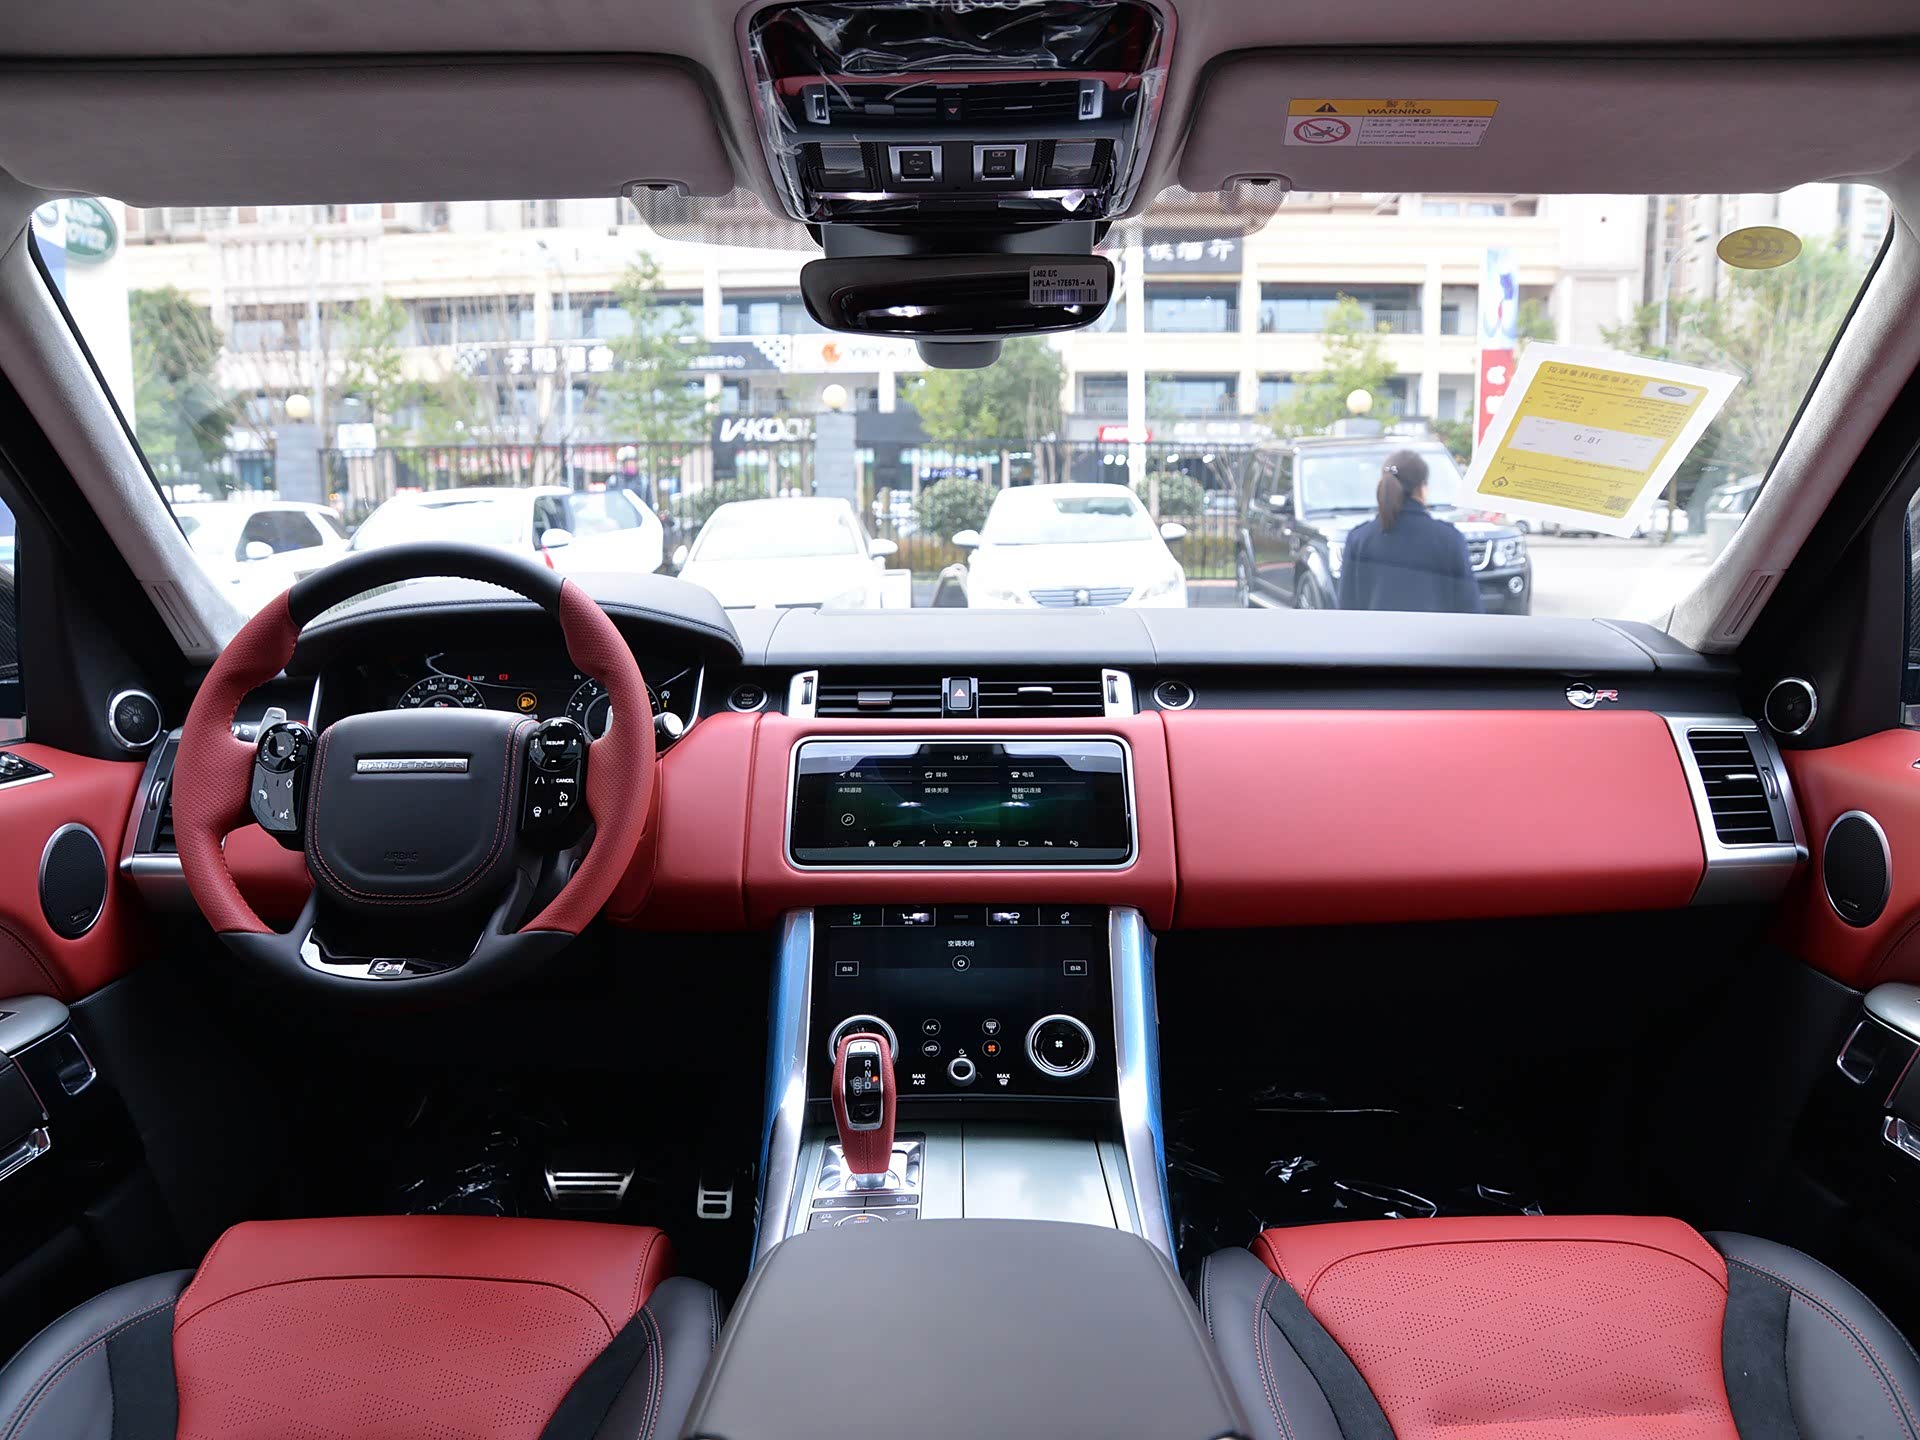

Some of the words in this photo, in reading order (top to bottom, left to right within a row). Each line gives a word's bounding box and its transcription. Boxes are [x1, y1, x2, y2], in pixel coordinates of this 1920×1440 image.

[1048, 269, 1058, 278] E/C
[427, 683, 438, 691] 140
[448, 683, 459, 691] 180
[591, 687, 598, 696] 3
[576, 702, 584, 711] 2
[361, 761, 410, 770] RANGE
[414, 761, 466, 769] ROVER
